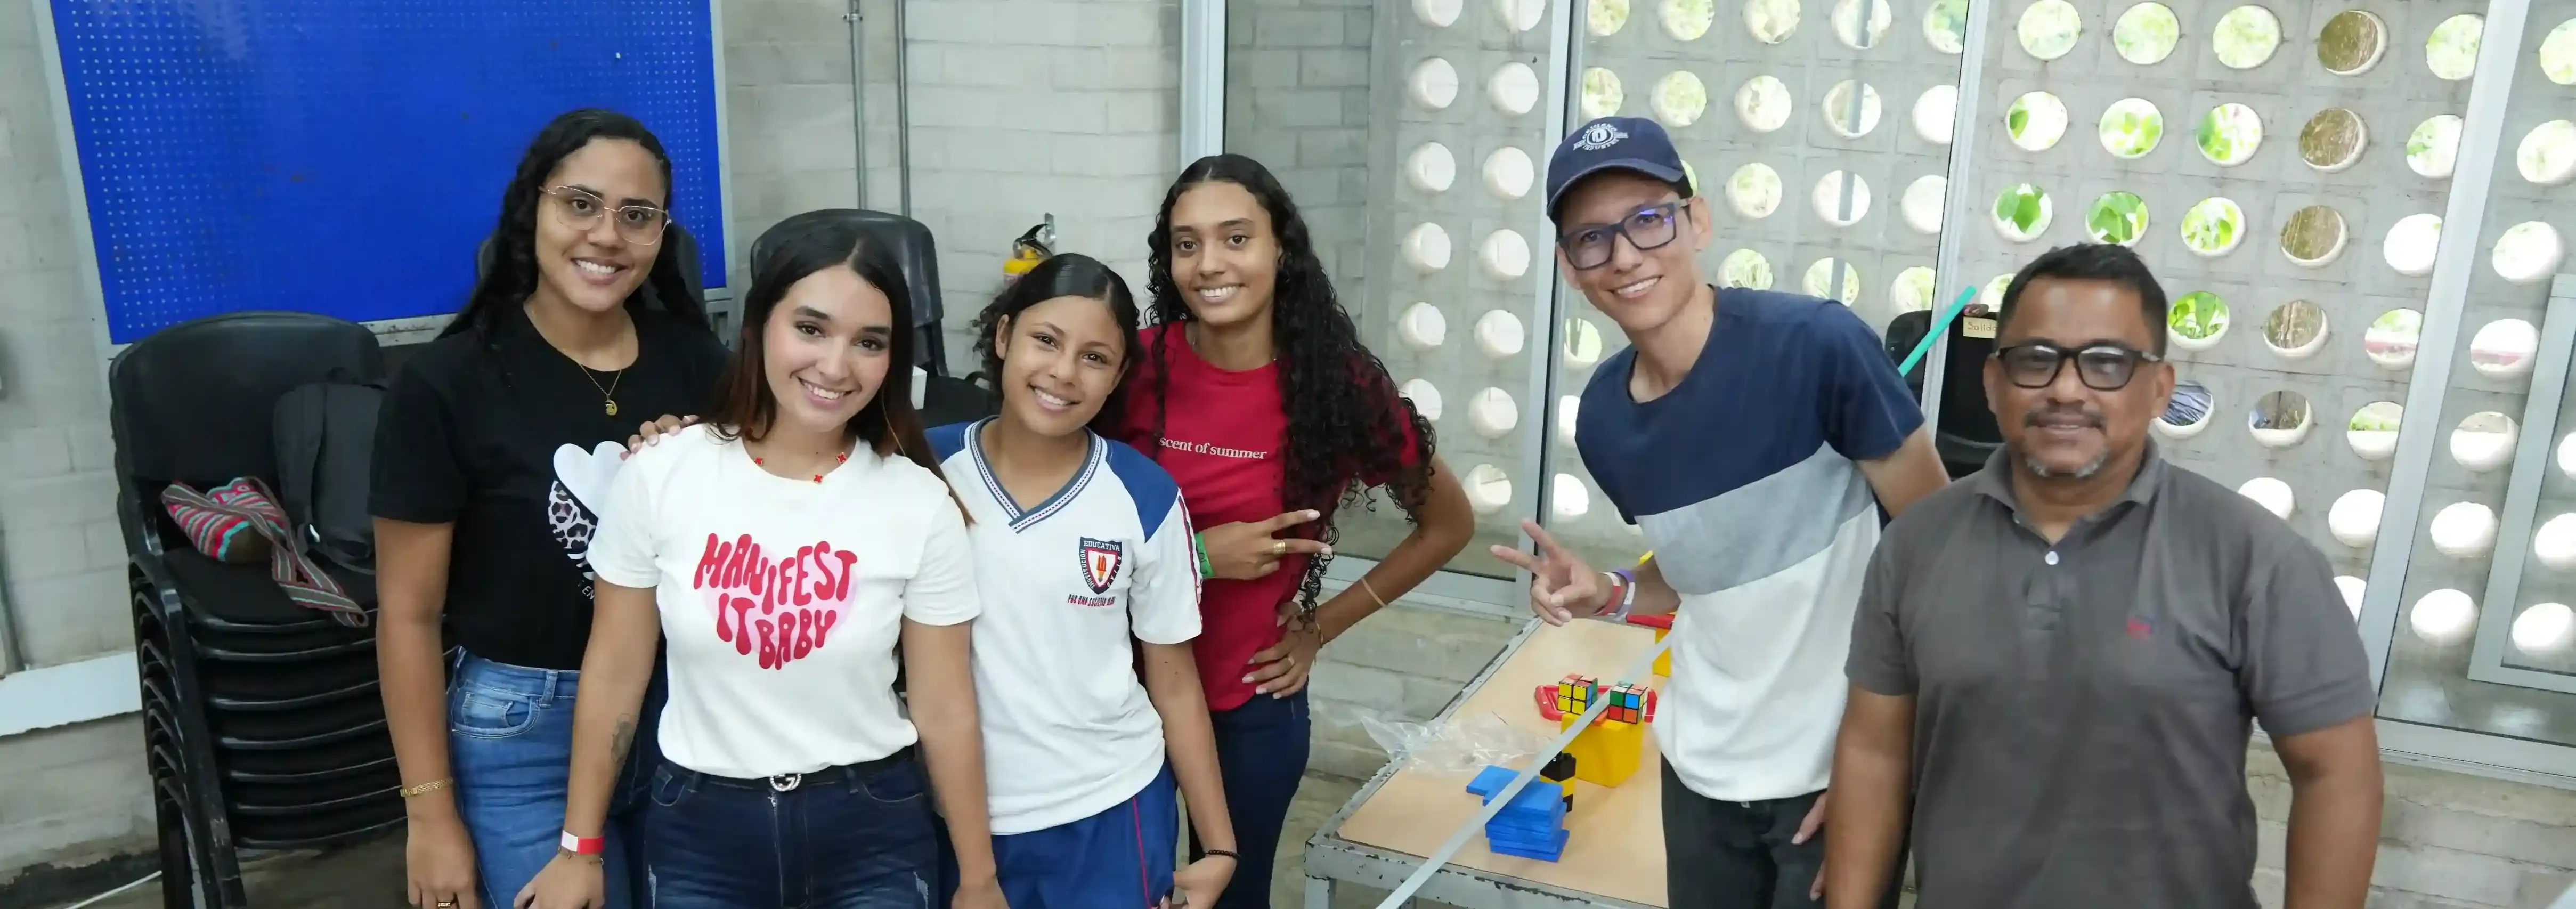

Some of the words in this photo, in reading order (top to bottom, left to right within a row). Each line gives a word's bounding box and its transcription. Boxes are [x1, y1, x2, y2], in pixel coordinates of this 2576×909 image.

[1159, 437, 1192, 452] scent
[1194, 442, 1210, 454] of
[1210, 446, 1267, 459] summer
[1083, 540, 1120, 551] EDUCATIVA
[694, 533, 857, 615] MANIFEST
[717, 593, 757, 655] IT
[754, 608, 836, 670] BABY
